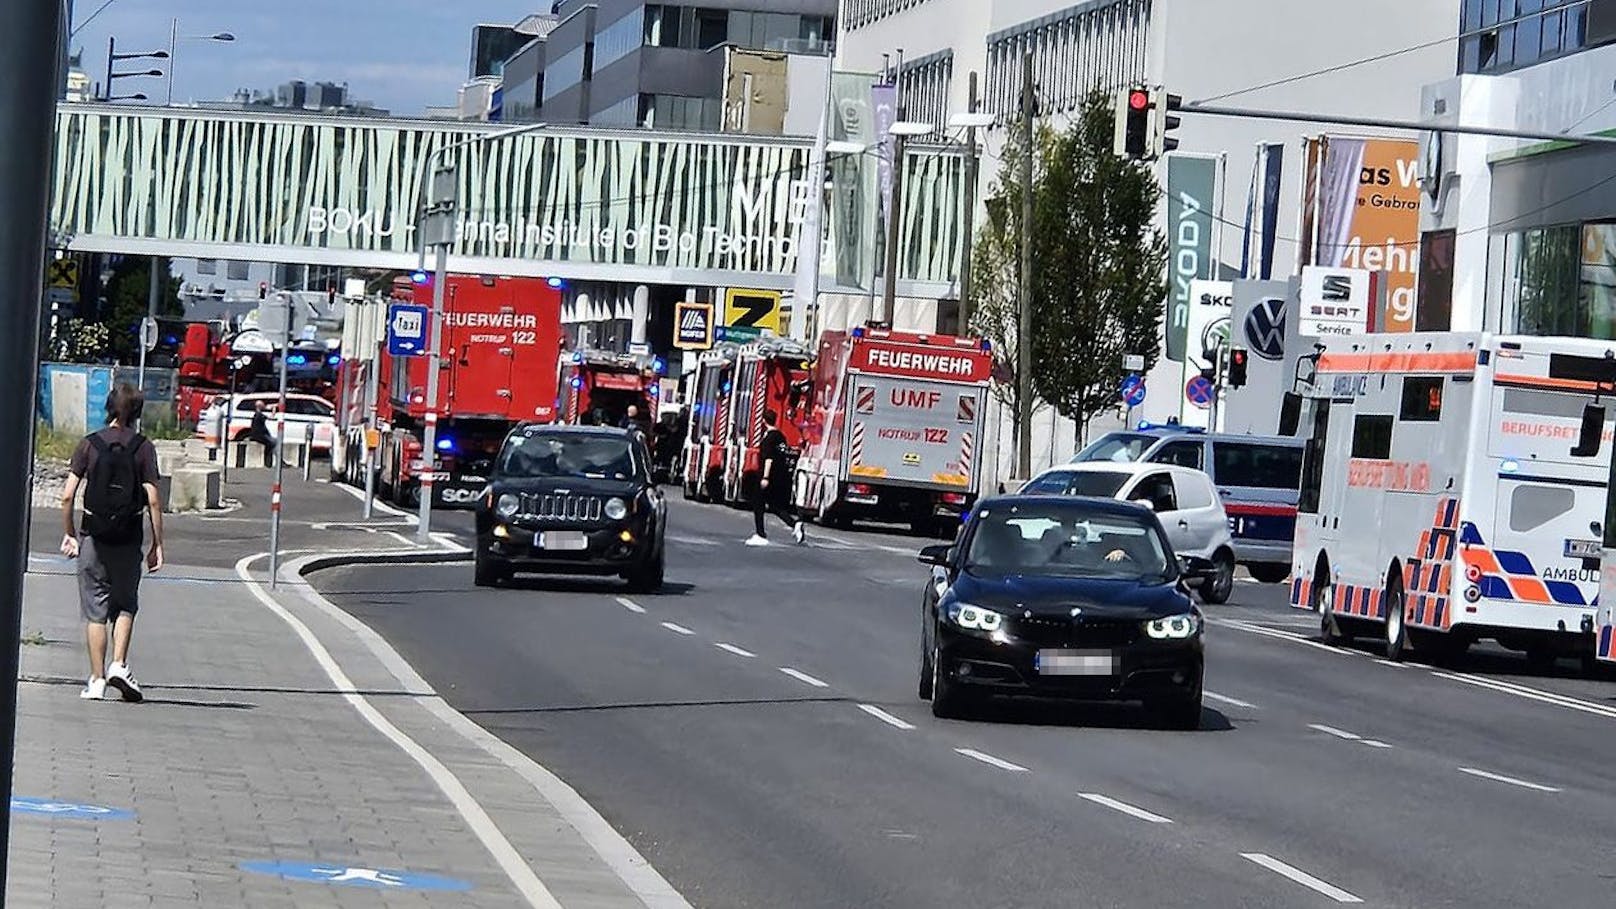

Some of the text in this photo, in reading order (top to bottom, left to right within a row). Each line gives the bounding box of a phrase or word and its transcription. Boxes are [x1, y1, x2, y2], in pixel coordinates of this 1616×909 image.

[1359, 167, 1390, 186] as
[1371, 193, 1420, 210] Gebra
[308, 206, 395, 237] BOKU
[518, 216, 616, 249] Institute
[622, 224, 649, 251] of
[1310, 305, 1361, 319] SEAT
[397, 316, 420, 332] Taxi
[1316, 322, 1352, 336] Service
[511, 331, 536, 345] 122
[868, 348, 974, 376] FEUERWEHR
[890, 388, 942, 409] UMF
[877, 428, 949, 444] NOTRUF 122
[1542, 566, 1600, 583] AMBUL
